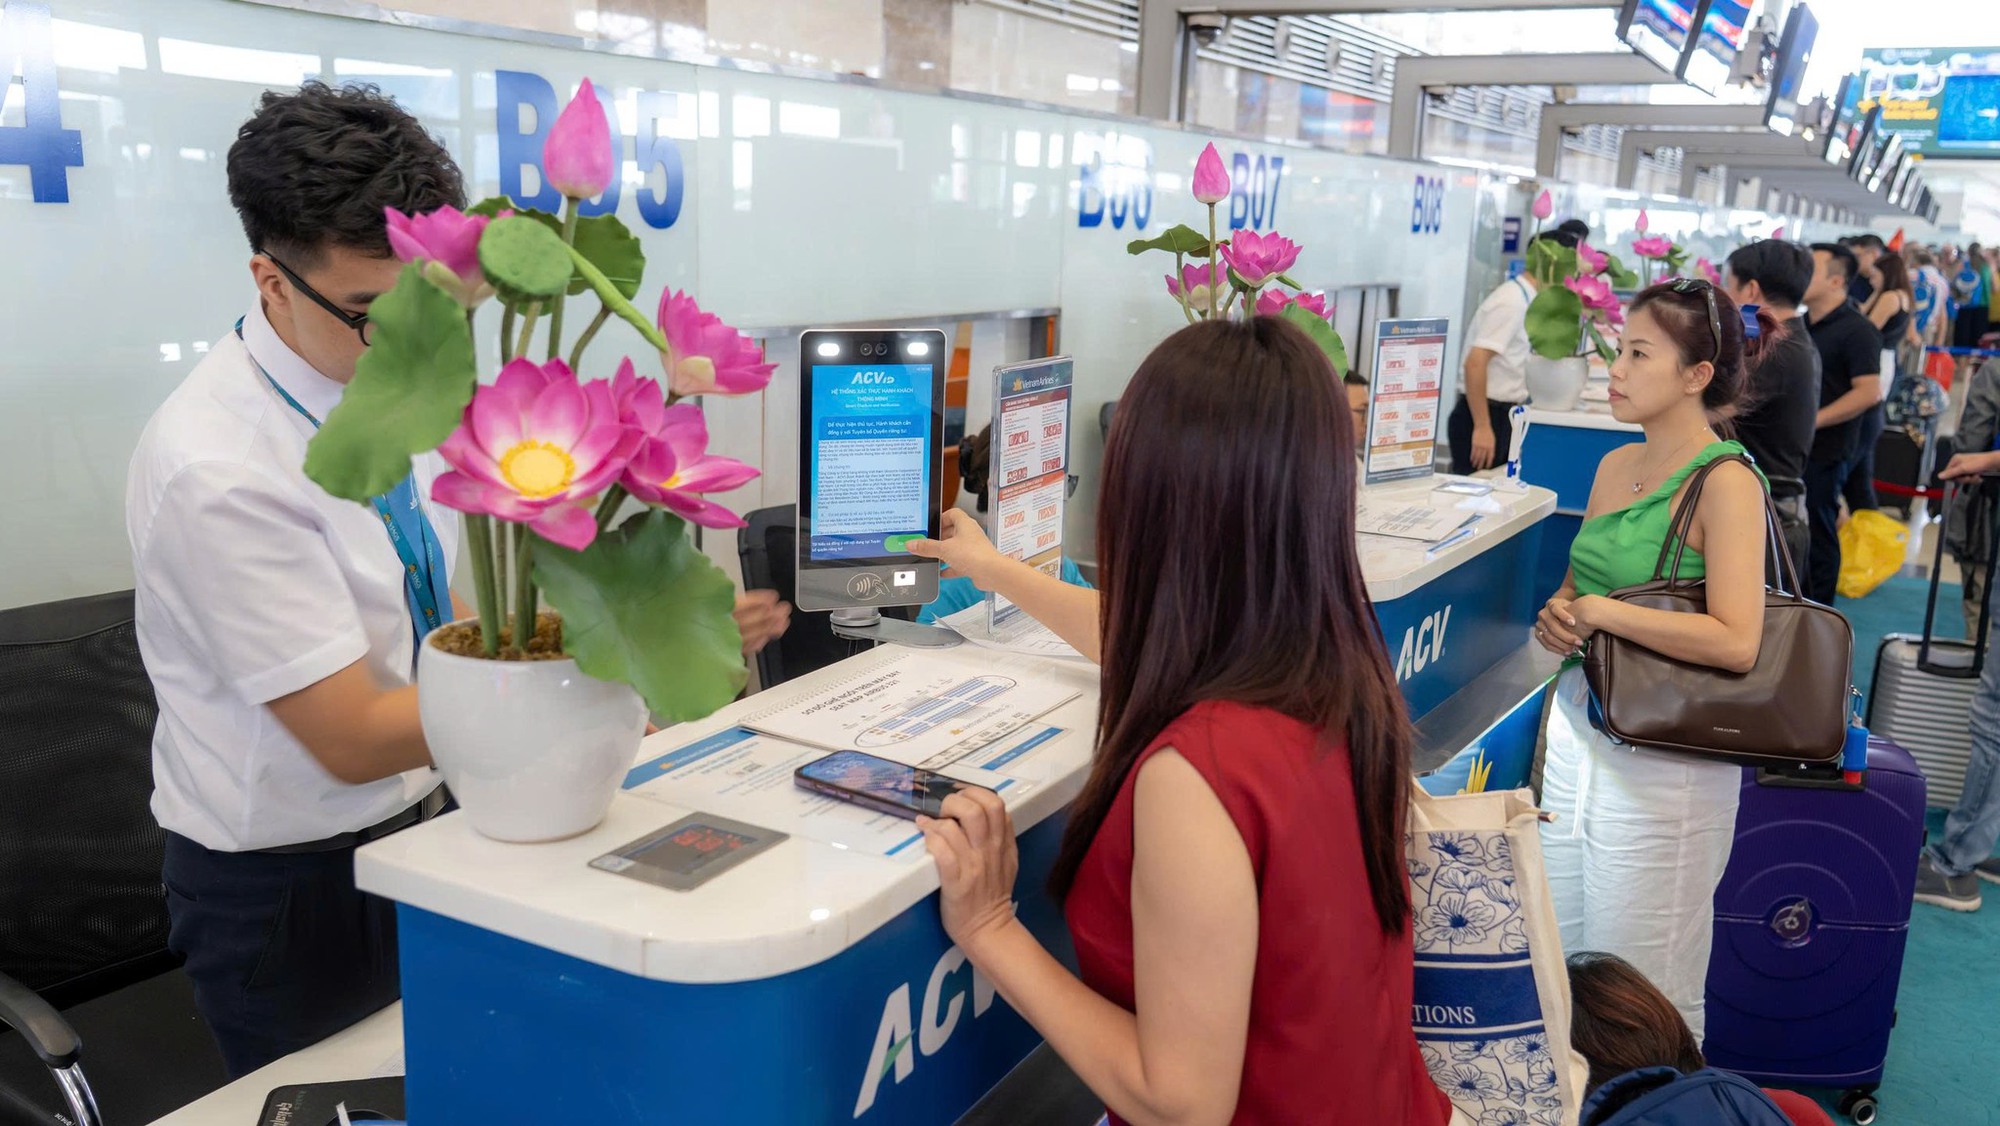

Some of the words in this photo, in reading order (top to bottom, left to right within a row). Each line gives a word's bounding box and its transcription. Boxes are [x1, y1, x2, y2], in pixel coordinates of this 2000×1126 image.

[1230, 153, 1283, 229] B07
[1411, 175, 1443, 233] B08
[1022, 379, 1040, 389] Vietnam
[1040, 376, 1054, 386] Airlines
[1395, 604, 1451, 684] ACV
[1412, 1004, 1476, 1024] TIONS
